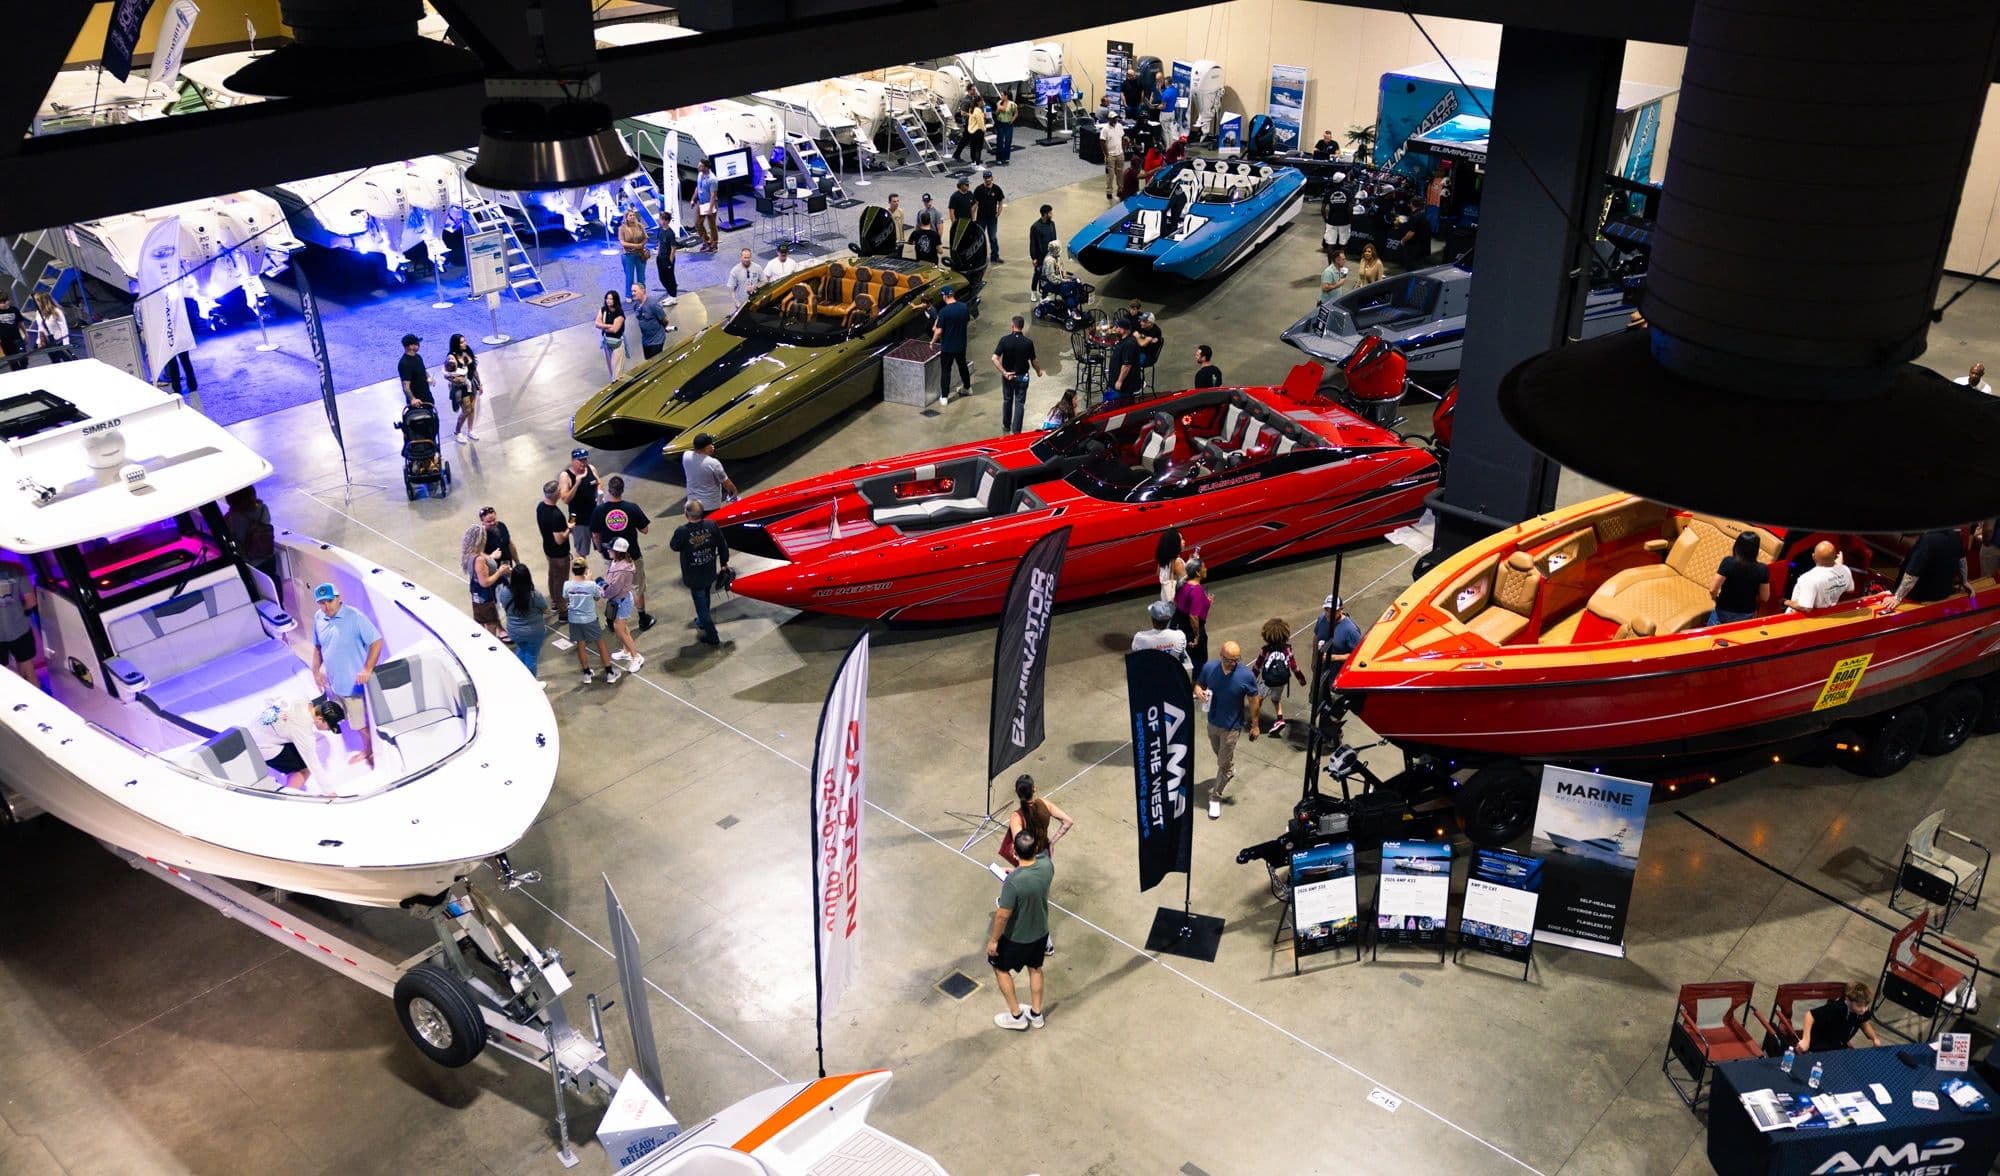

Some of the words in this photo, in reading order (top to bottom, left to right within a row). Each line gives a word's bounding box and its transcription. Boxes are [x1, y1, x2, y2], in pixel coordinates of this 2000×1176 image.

[1430, 145, 1487, 160] ELIMINATO
[82, 418, 122, 436] SIMRAD
[1832, 667, 1862, 684] BOAT
[1827, 679, 1856, 693] SHOW
[1147, 705, 1160, 732] OF
[1135, 712, 1148, 796] PERFORMANCE
[1149, 736, 1162, 775] THE
[1163, 701, 1188, 819] AMP
[1150, 776, 1164, 827] WEST
[1555, 795, 1609, 809] PROTECTION
[1556, 781, 1634, 806] MARINE
[1140, 799, 1151, 838] BOATS
[1580, 897, 1616, 909] SELF-HEALING
[1576, 919, 1603, 929] FLAWLESS
[1593, 911, 1615, 920] CLARITY
[1576, 930, 1610, 941] TECHNOLOGY
[626, 1136, 656, 1155] READY
[1810, 1136, 1966, 1176] AMP
